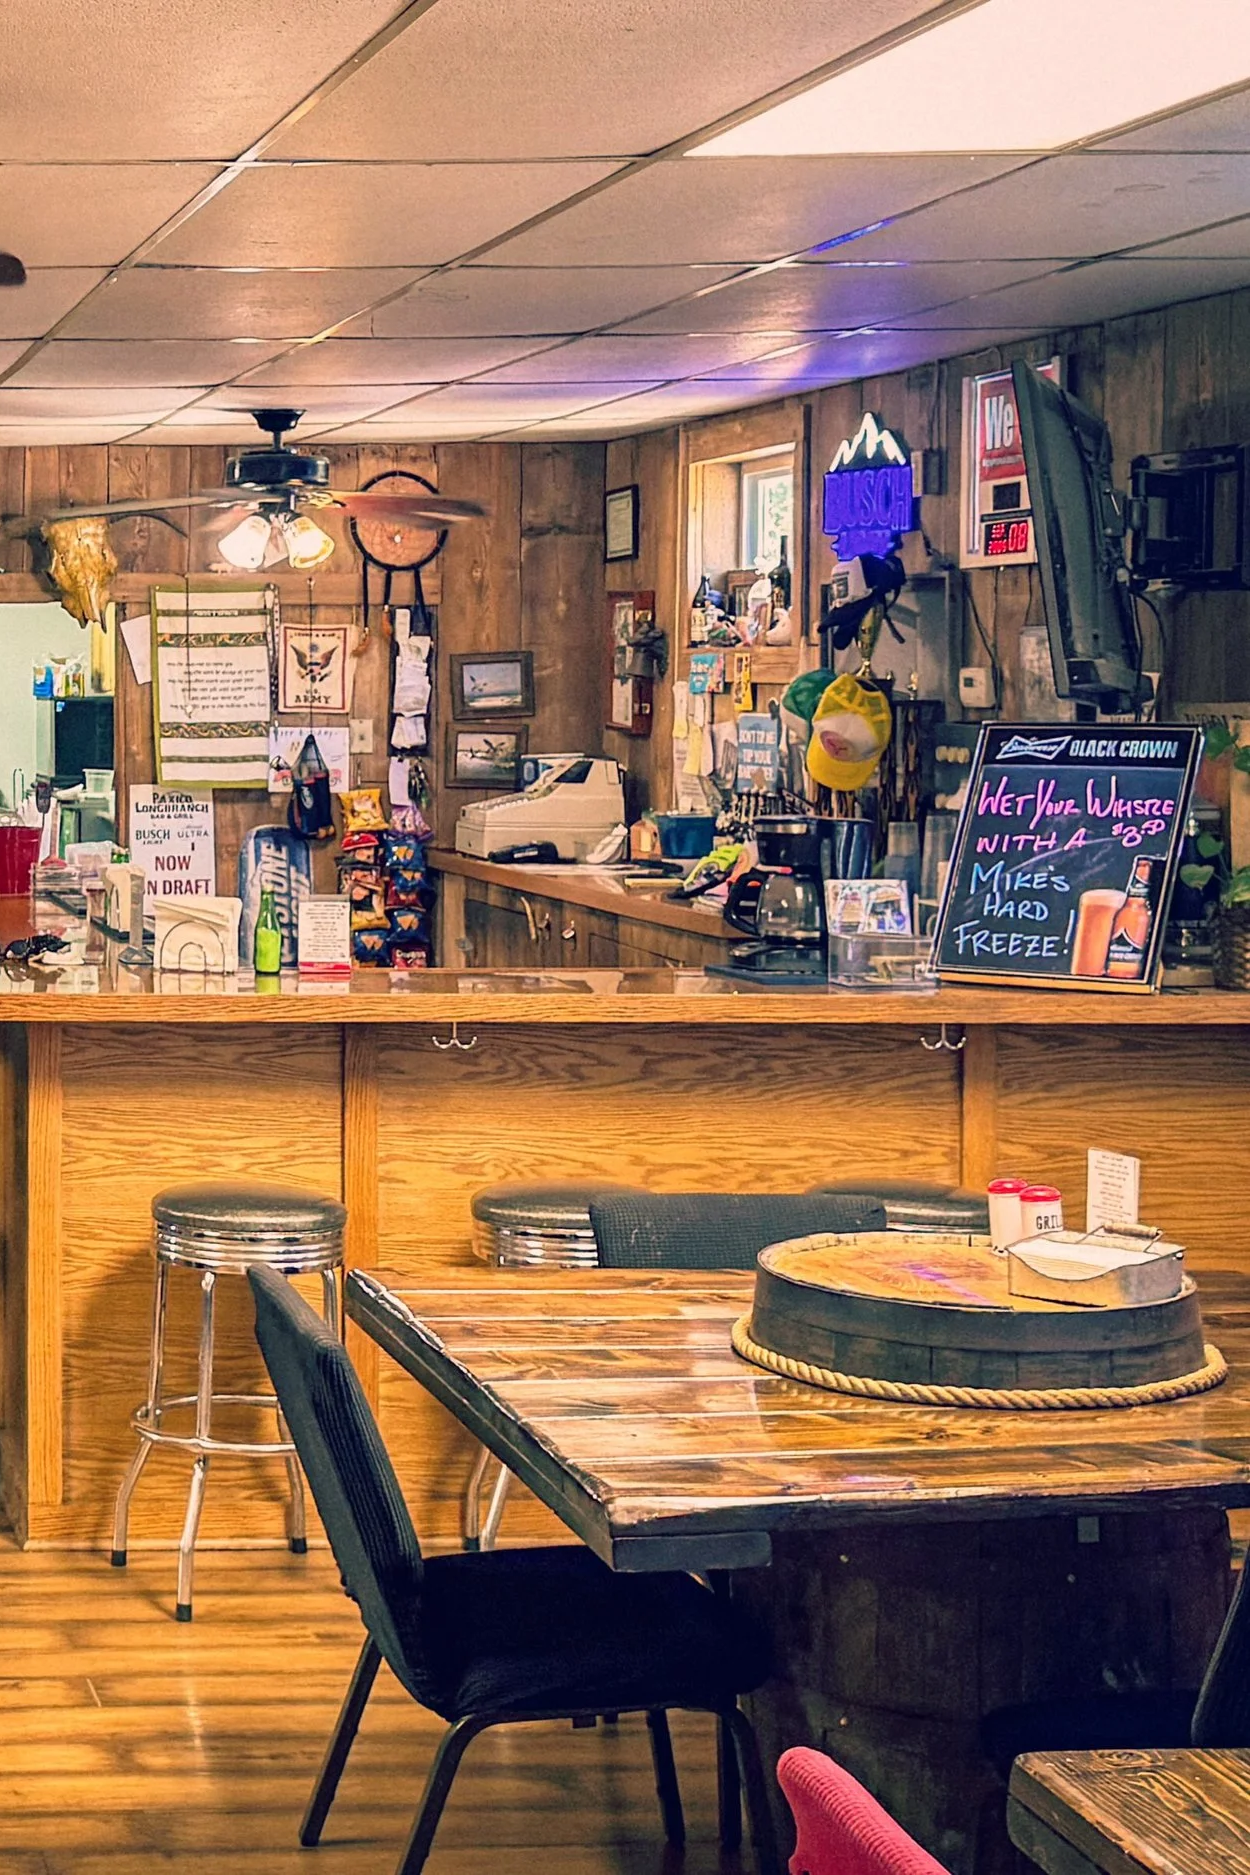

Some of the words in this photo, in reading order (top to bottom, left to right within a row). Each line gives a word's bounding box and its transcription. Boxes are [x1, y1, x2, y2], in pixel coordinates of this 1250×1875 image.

[985, 395, 1014, 450] We
[824, 466, 911, 532] BUSCH
[294, 695, 331, 704] ARMY
[1069, 740, 1117, 757] BLACK
[1119, 741, 1178, 759] CROWN
[152, 792, 193, 804] PAXICO
[977, 776, 1036, 816] WET
[136, 829, 170, 840] BUSCH
[177, 830, 209, 838] ULTRA
[976, 831, 1057, 854] WITH
[1063, 827, 1087, 851] A
[154, 855, 191, 872] NOW
[162, 879, 211, 896] DRAFT
[970, 860, 1071, 895] MIKE'S
[983, 891, 1049, 921] HARD
[953, 909, 1075, 957] FREEZE!
